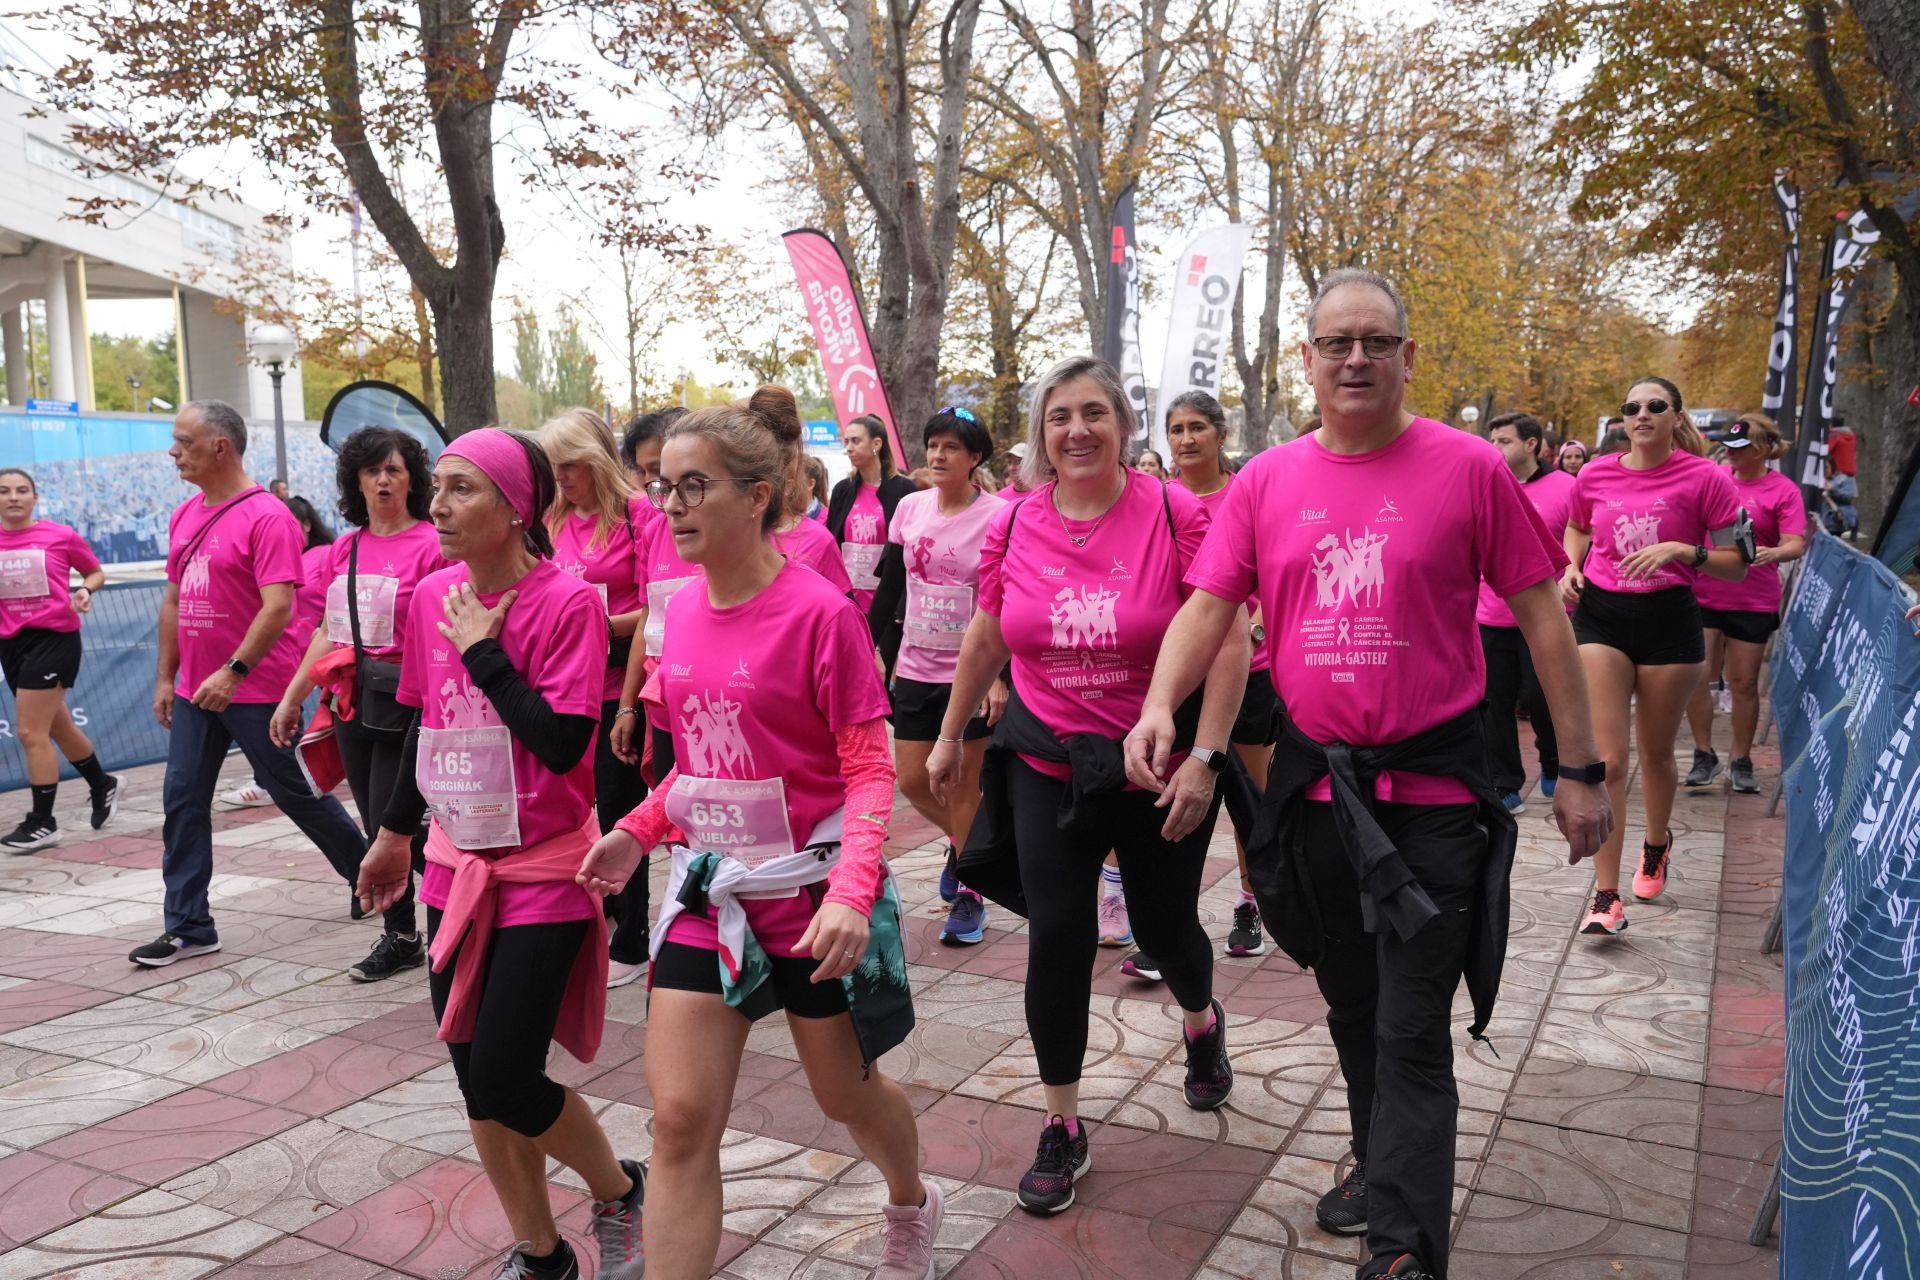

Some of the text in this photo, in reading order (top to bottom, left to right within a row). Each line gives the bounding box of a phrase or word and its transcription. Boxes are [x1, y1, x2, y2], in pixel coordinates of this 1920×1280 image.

[1189, 274, 1230, 399] RREO
[1301, 508, 1327, 521] Vital
[657, 563, 670, 571] Vital
[1041, 566, 1065, 576] Vital
[920, 595, 956, 612] 1344
[432, 649, 449, 662] Vital
[1304, 652, 1387, 667] VITORIA-GASTEIZ
[669, 663, 691, 676] Vital
[728, 680, 755, 689] ASAMMA
[1050, 671, 1129, 689] VITORIA-GASTEIZ
[432, 751, 473, 775] 165
[430, 778, 483, 792] SORGIÑAK
[691, 803, 745, 828] 653
